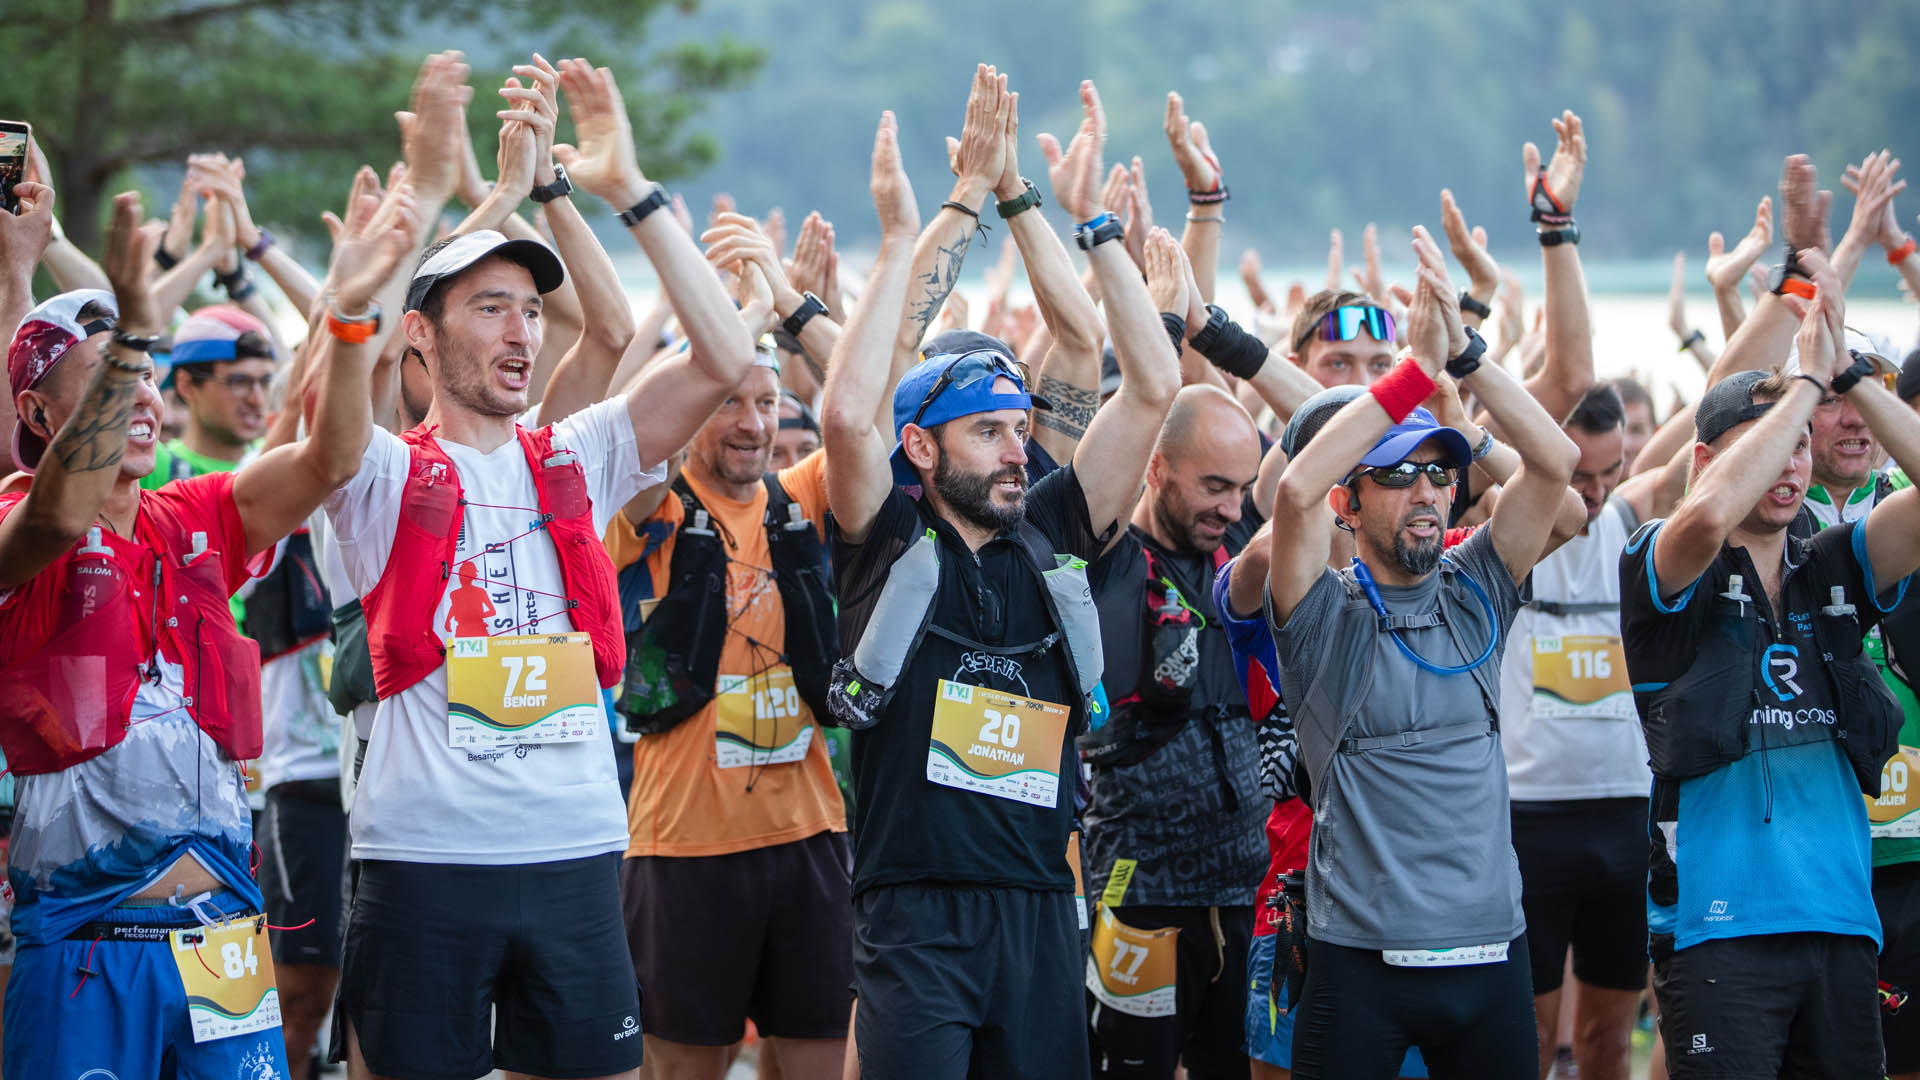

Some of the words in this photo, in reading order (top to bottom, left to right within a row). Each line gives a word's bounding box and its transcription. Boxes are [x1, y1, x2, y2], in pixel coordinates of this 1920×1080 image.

[501, 655, 547, 697] 72
[1568, 650, 1611, 679] 116
[503, 694, 548, 708] BENOIT
[751, 685, 800, 720] 120
[1025, 700, 1044, 712] 70KM
[978, 708, 1021, 749] 20
[467, 752, 505, 763] Besançon
[967, 743, 1025, 767] JONATHAN
[124, 931, 165, 941] recovery
[221, 936, 258, 980] 84
[1110, 937, 1149, 976] 77
[614, 1032, 625, 1040] BV
